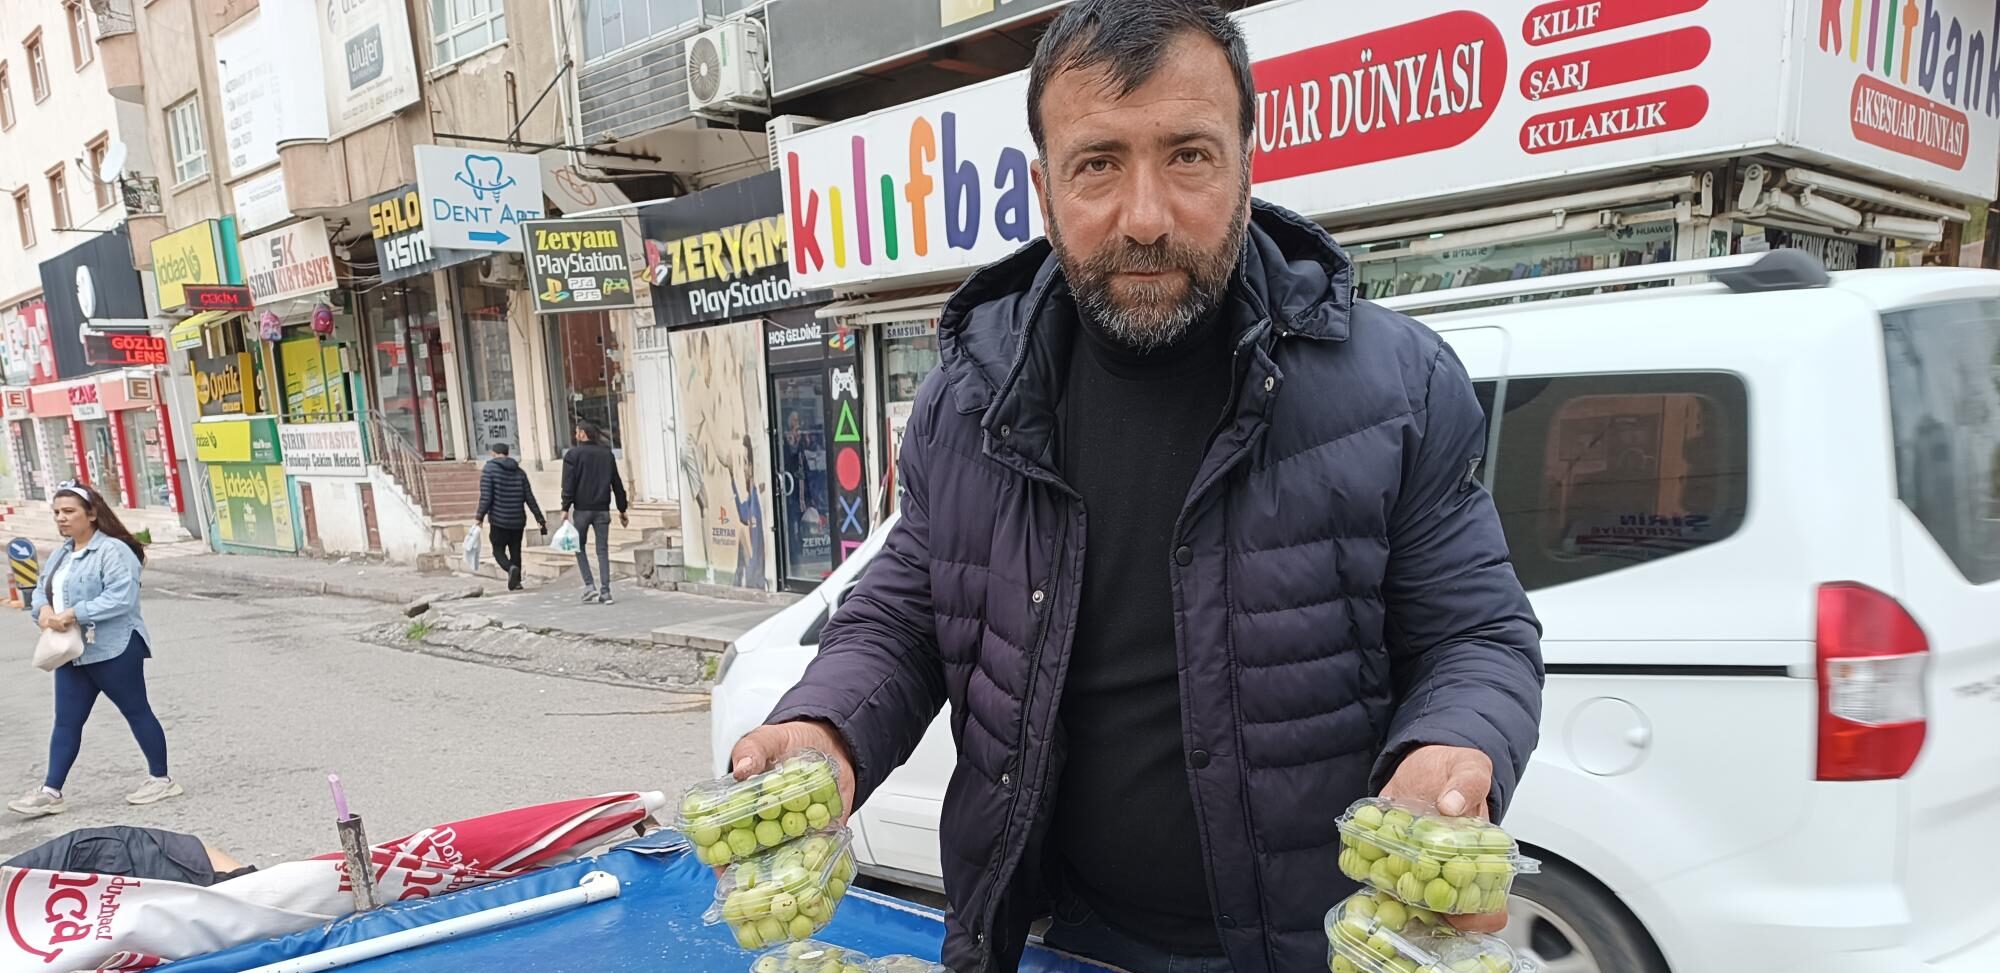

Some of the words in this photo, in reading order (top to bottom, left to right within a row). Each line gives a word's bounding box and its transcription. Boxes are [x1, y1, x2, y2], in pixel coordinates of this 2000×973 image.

[1531, 1, 1600, 41] KILIF
[1529, 60, 1591, 100] ŞARJ
[1252, 79, 1323, 154] UAR
[1329, 39, 1485, 140] DÜNYASI
[1527, 101, 1667, 150] KULAKLIK
[1854, 85, 1915, 141] AKSESUAR
[1916, 102, 1966, 157] DÜNYASI
[369, 191, 423, 240] SALO
[433, 198, 492, 223] DENT
[384, 229, 432, 272] KSM
[535, 230, 618, 251] Zeryam
[665, 213, 789, 287] ZERYAM
[156, 253, 187, 286] iddaa
[570, 279, 595, 289] PS4
[575, 292, 601, 300] PS5
[688, 275, 807, 319] PlayStatio
[768, 331, 785, 347] HOŞ
[786, 323, 822, 343] GELDİNİZ
[887, 324, 926, 338] SAMSUNG
[125, 350, 165, 363] LENS
[132, 380, 149, 397] E
[209, 363, 239, 402] Optik
[9, 393, 24, 406] E
[483, 408, 510, 422] SALON
[333, 452, 361, 468] Merkezi
[224, 471, 254, 499] iddaa
